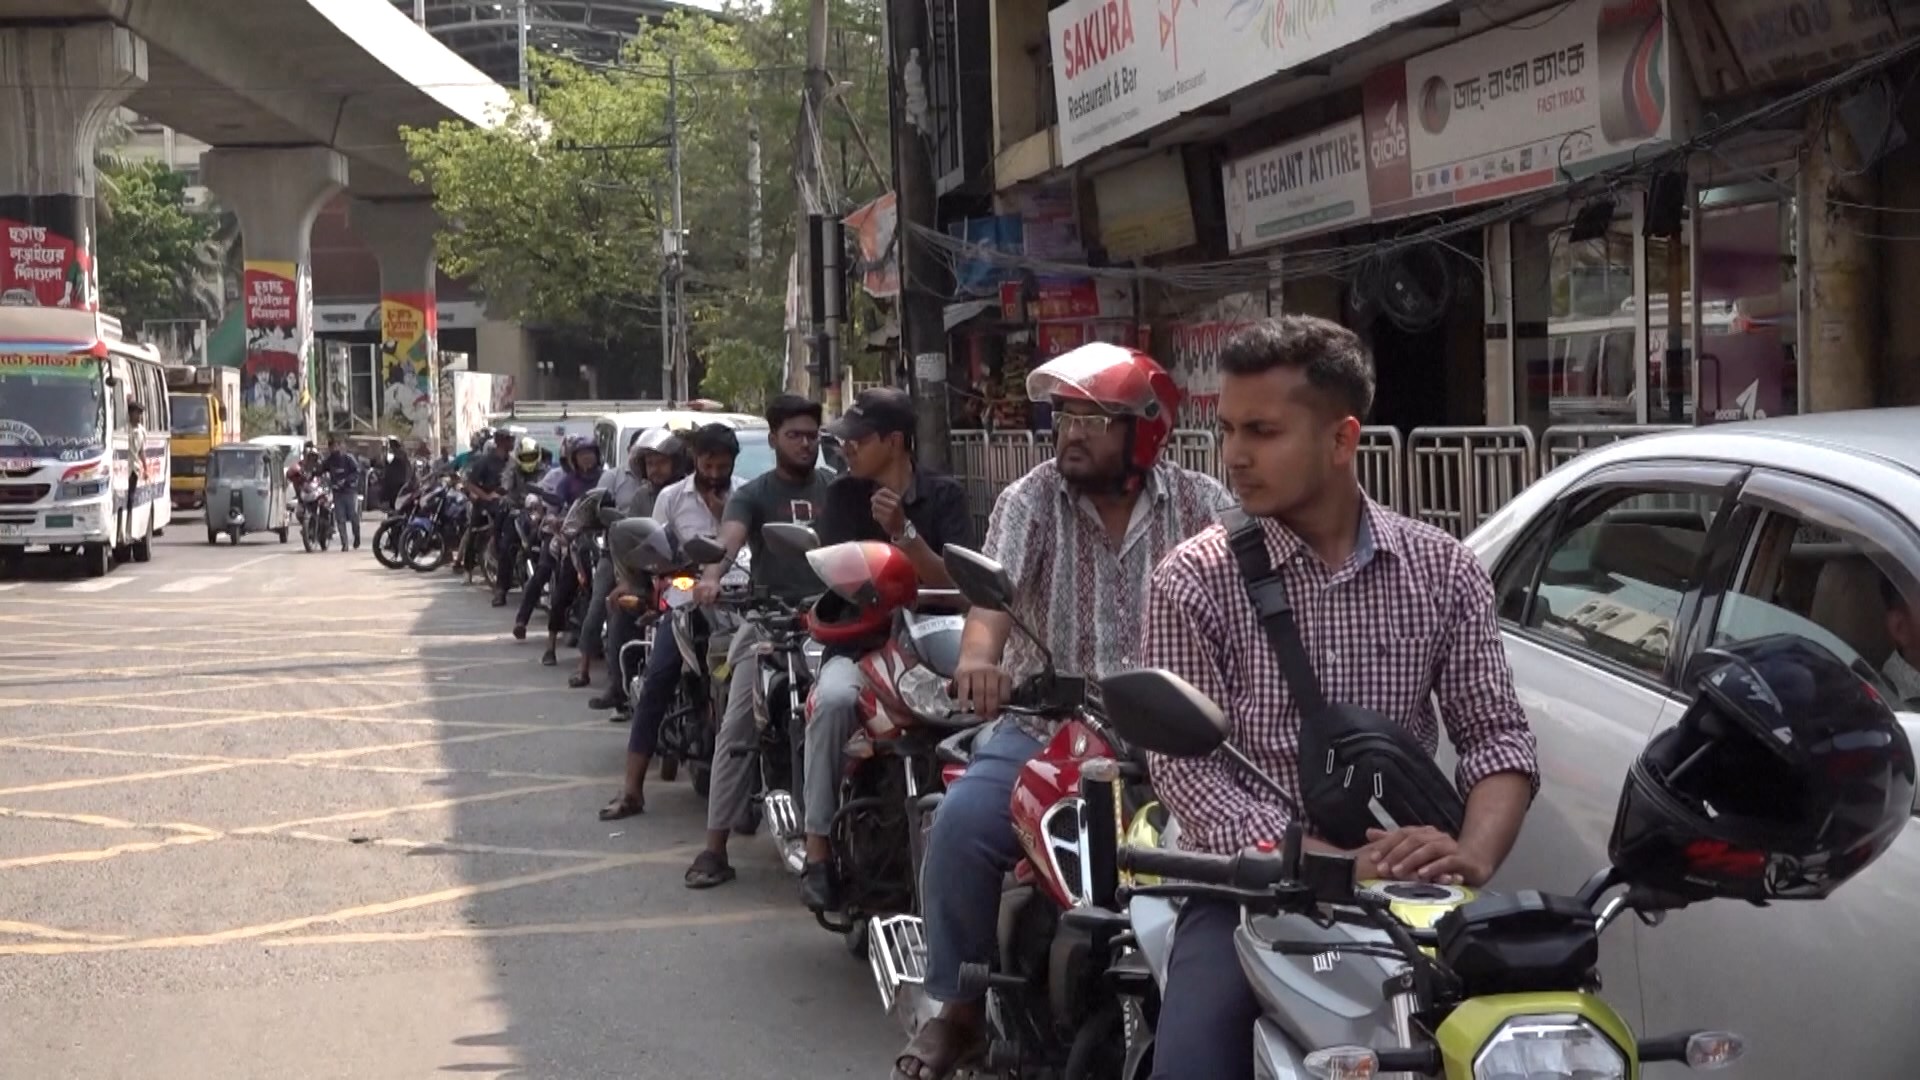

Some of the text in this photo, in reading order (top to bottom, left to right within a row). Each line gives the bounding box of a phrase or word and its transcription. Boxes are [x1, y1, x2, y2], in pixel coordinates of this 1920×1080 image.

[1063, 0, 1134, 80] SAKURA
[1533, 42, 1585, 86] ব্যাংক
[1067, 66, 1138, 121] Restaurant & Bar
[1537, 87, 1586, 114] FAST TRACK
[1245, 151, 1304, 202] ELEGANT
[1309, 132, 1361, 184] ATTIRE
